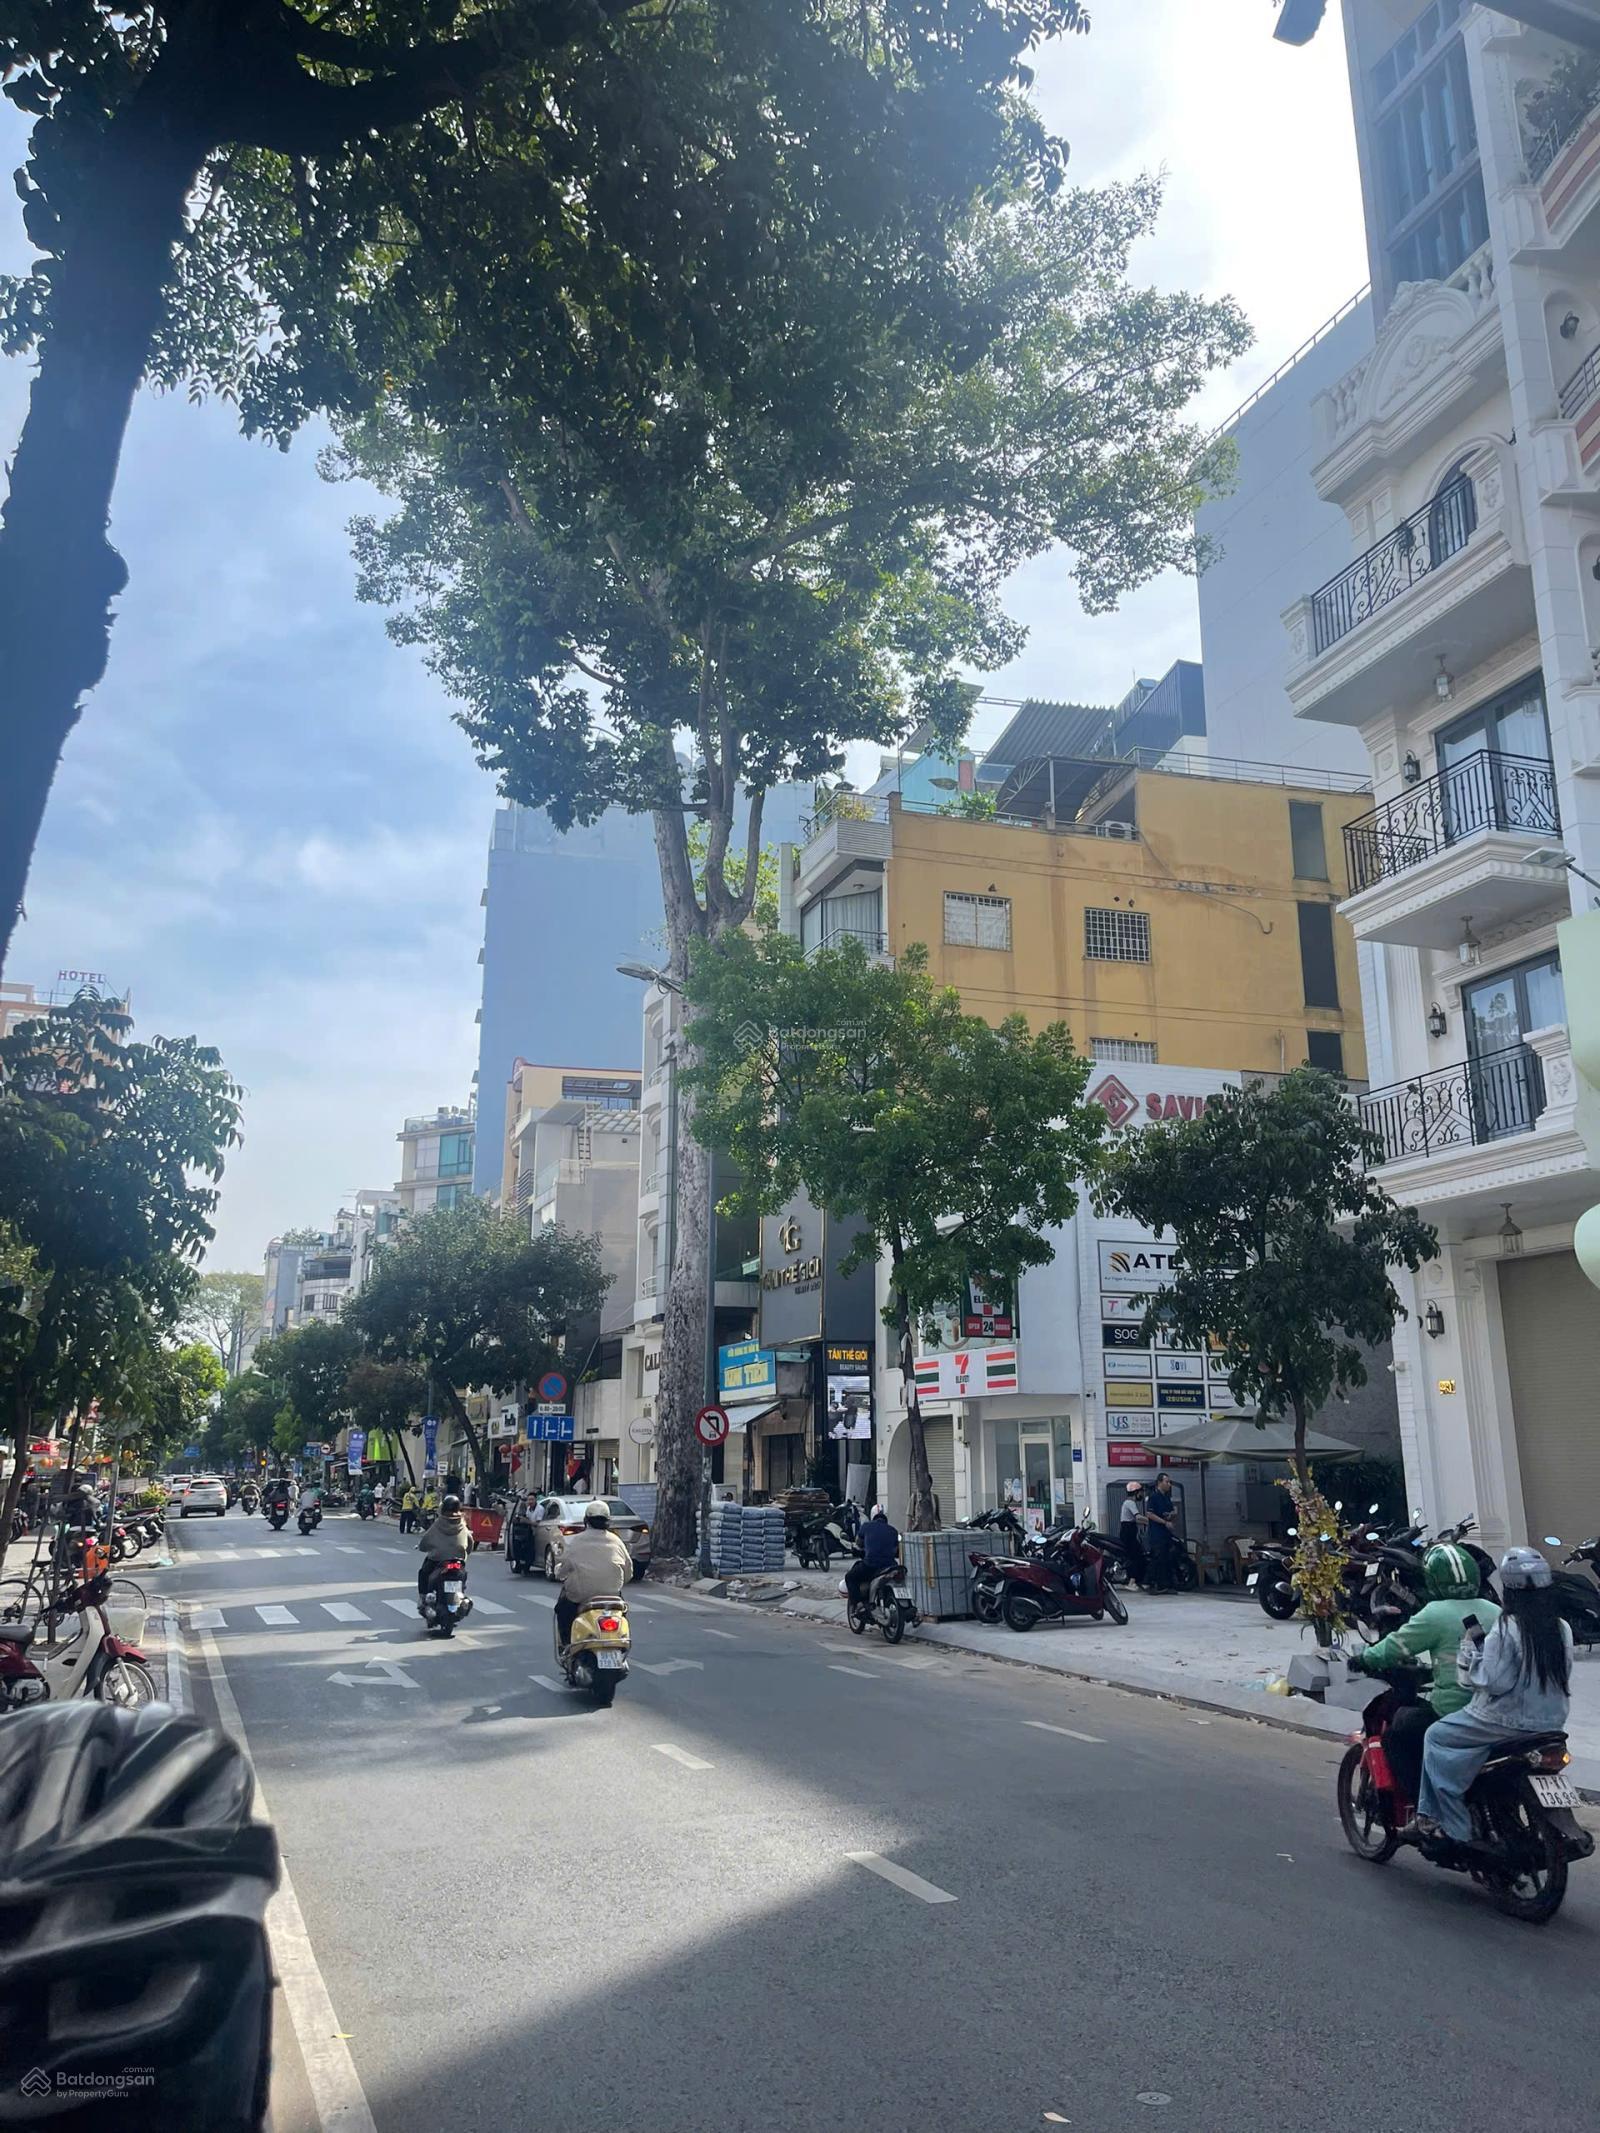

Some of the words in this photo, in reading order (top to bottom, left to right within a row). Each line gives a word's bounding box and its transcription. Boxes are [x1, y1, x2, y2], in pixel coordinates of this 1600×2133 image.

[58, 970, 104, 984] HOTEL
[1146, 1092, 1208, 1120] SAVI
[983, 1321, 994, 1332] 24
